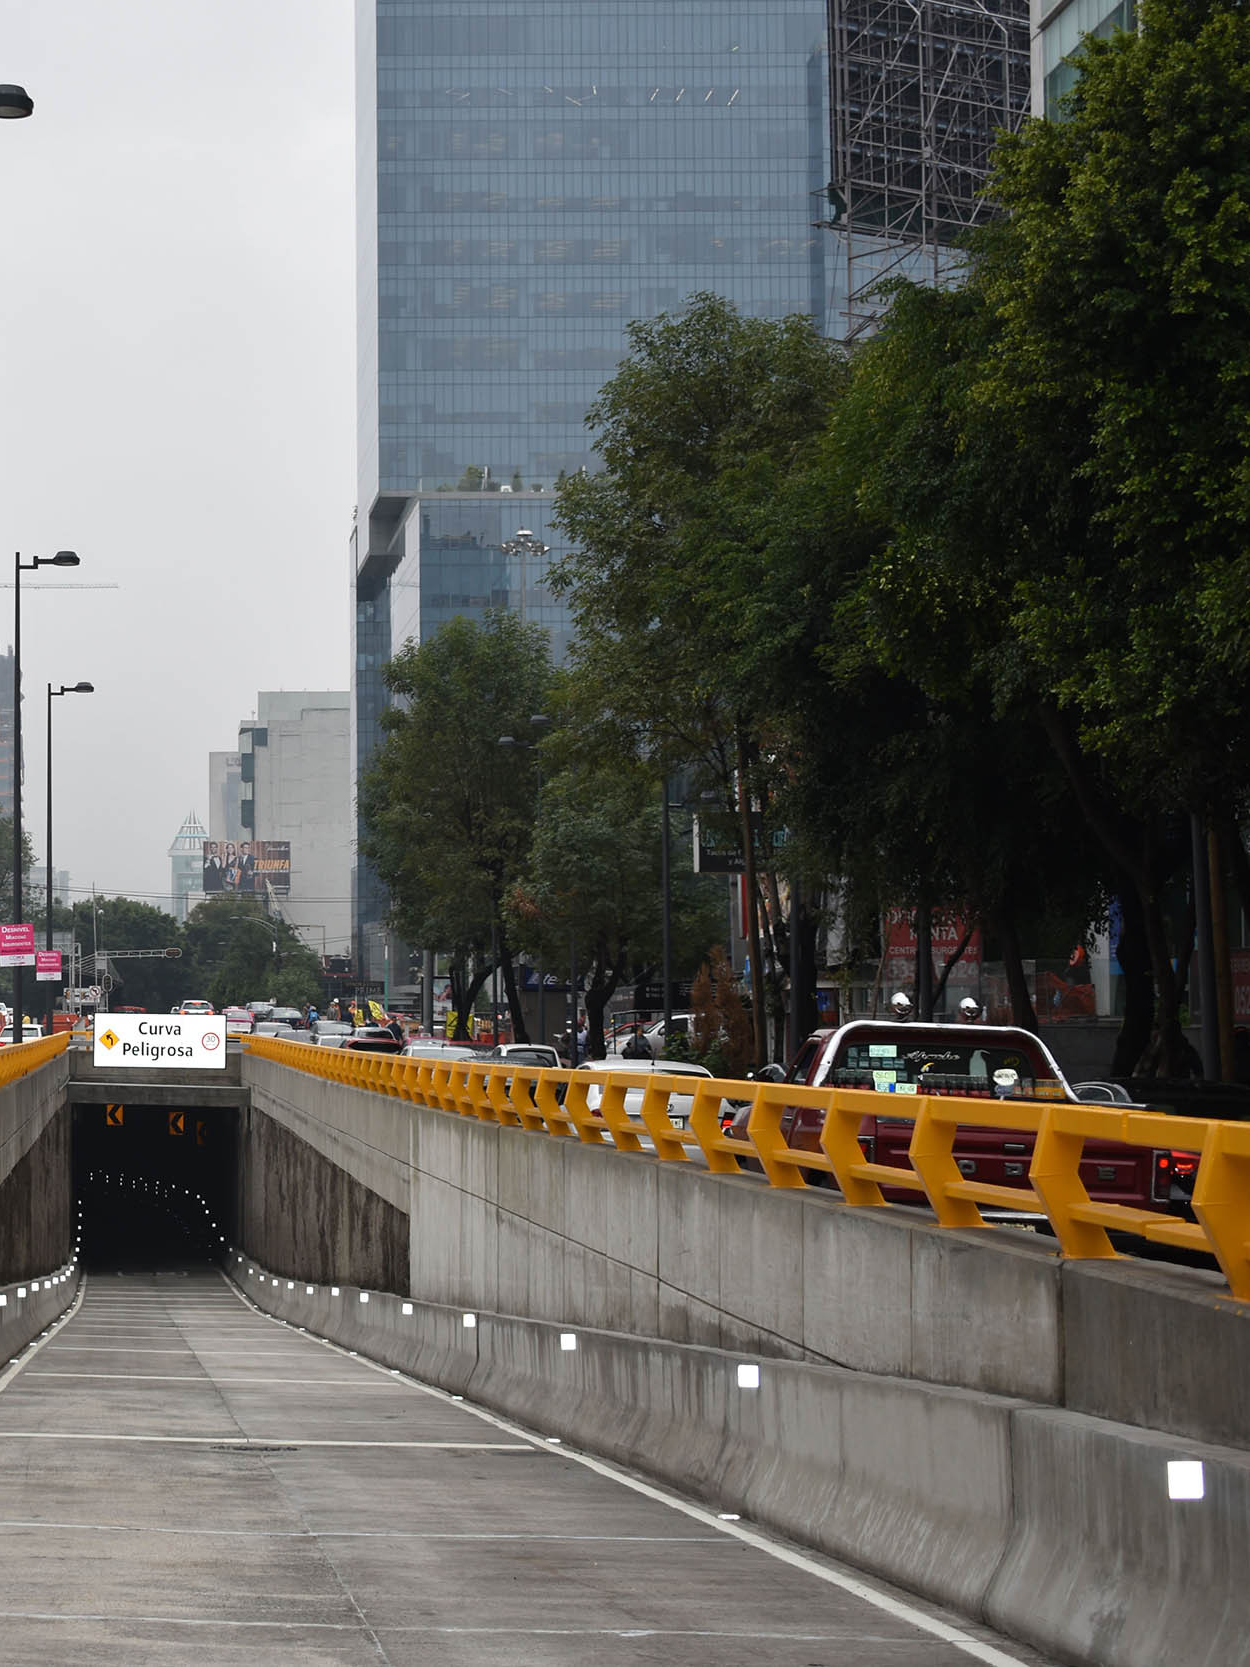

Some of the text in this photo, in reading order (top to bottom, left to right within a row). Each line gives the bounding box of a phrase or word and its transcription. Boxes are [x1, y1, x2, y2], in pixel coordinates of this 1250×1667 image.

[254, 859, 290, 870] TRIUNFA
[138, 1021, 182, 1036] Curva
[122, 1042, 193, 1061] Peligrosa
